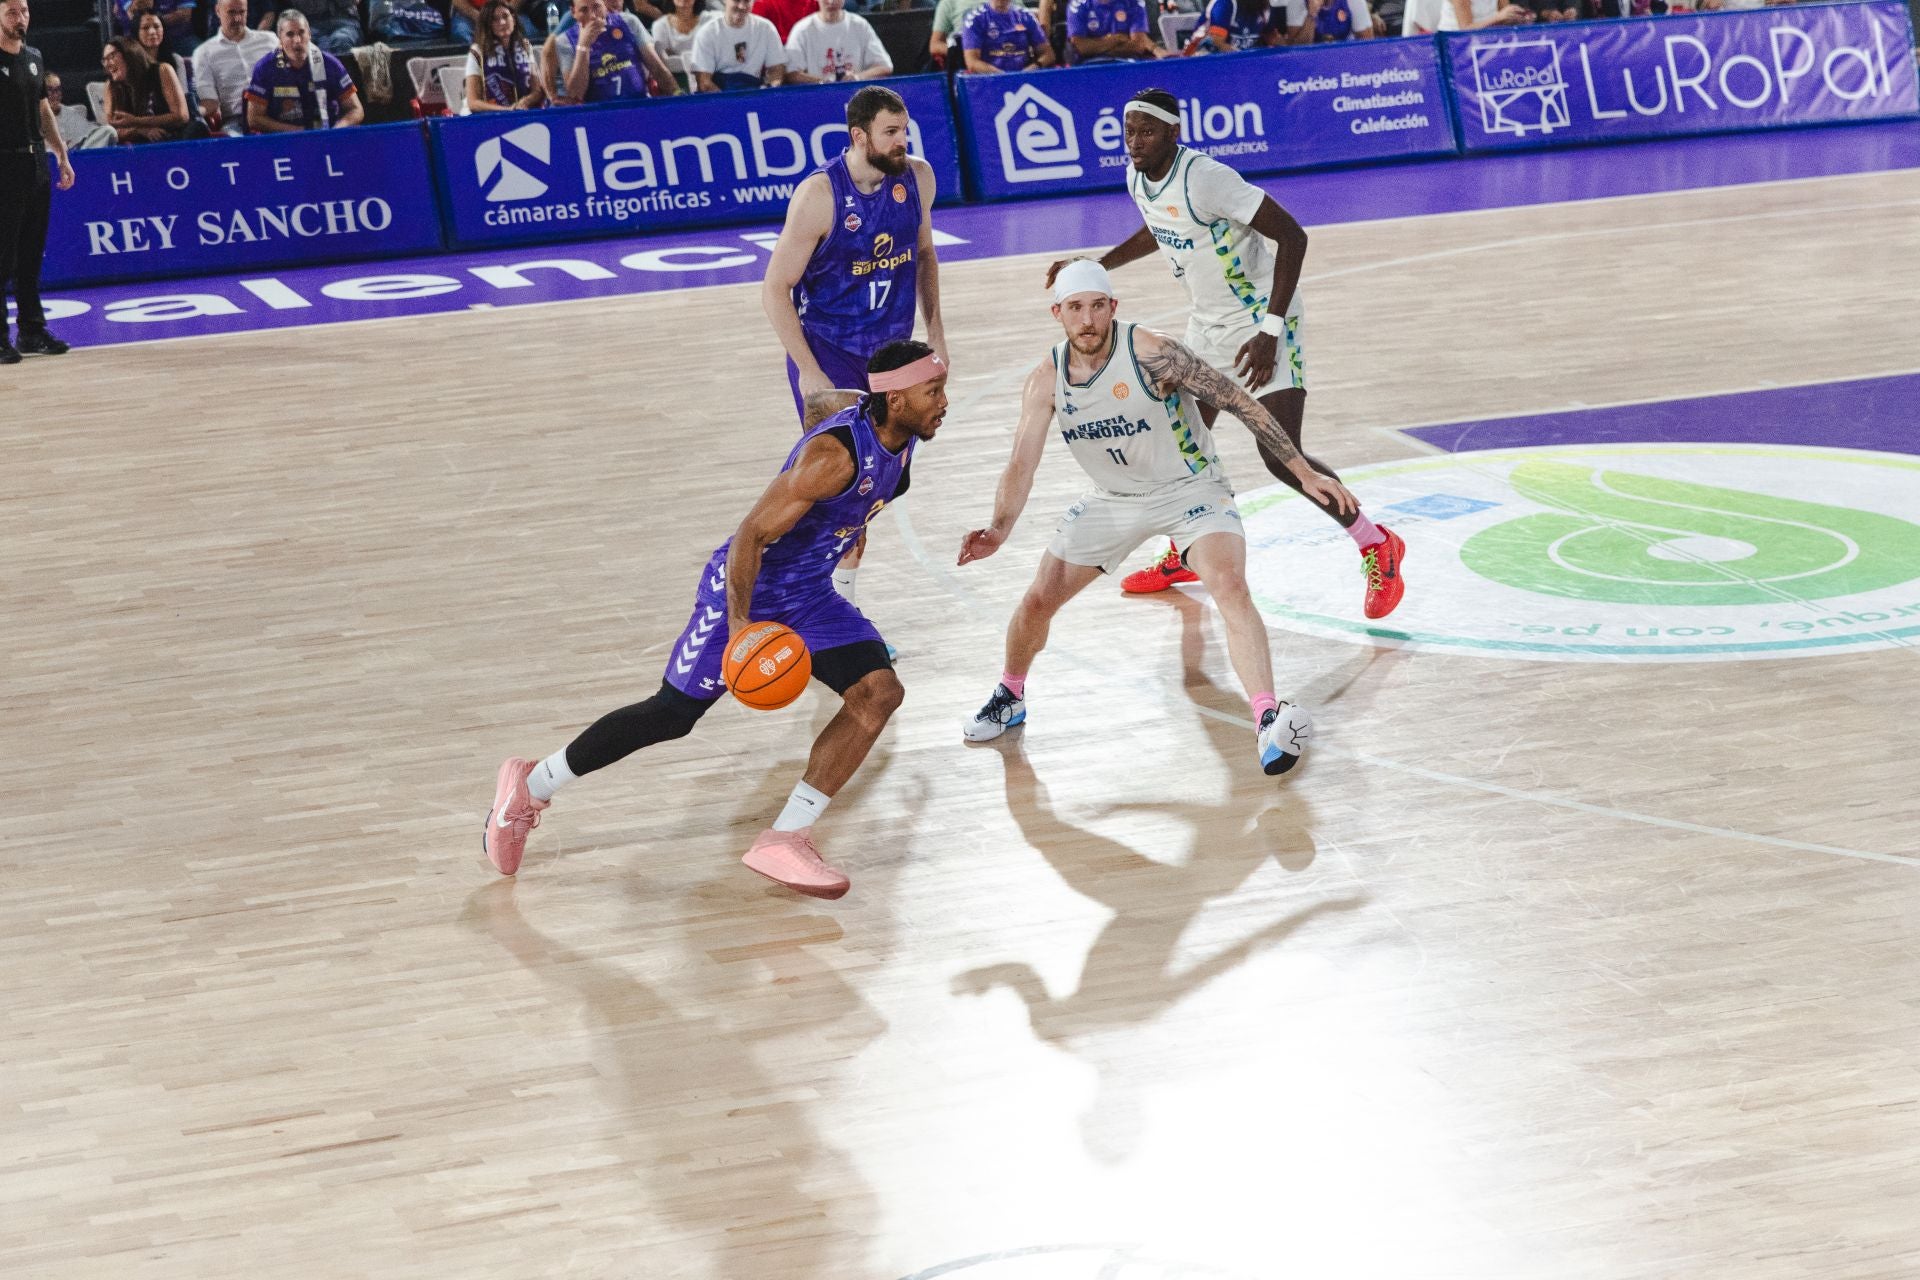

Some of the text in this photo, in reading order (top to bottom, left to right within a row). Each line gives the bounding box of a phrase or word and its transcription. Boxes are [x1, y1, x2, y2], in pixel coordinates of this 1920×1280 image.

[1278, 67, 1420, 95] Servicios Energéticos
[1483, 64, 1555, 90] LuRoPal
[1580, 19, 1891, 120] LuRoPal
[611, 75, 622, 96] 7
[1332, 90, 1425, 113] Climatización
[1093, 97, 1265, 154] éilon
[1351, 113, 1429, 134] Calefacción
[111, 154, 344, 196] HOTEL
[484, 201, 581, 226] cámaras
[585, 189, 711, 221] frigoríficas
[85, 197, 393, 256] REY SANCHO
[852, 248, 912, 276] agropal
[868, 279, 892, 311] 17
[1061, 418, 1152, 445] MENORCA
[1077, 414, 1127, 433] HESTIA
[1106, 447, 1129, 466] 11
